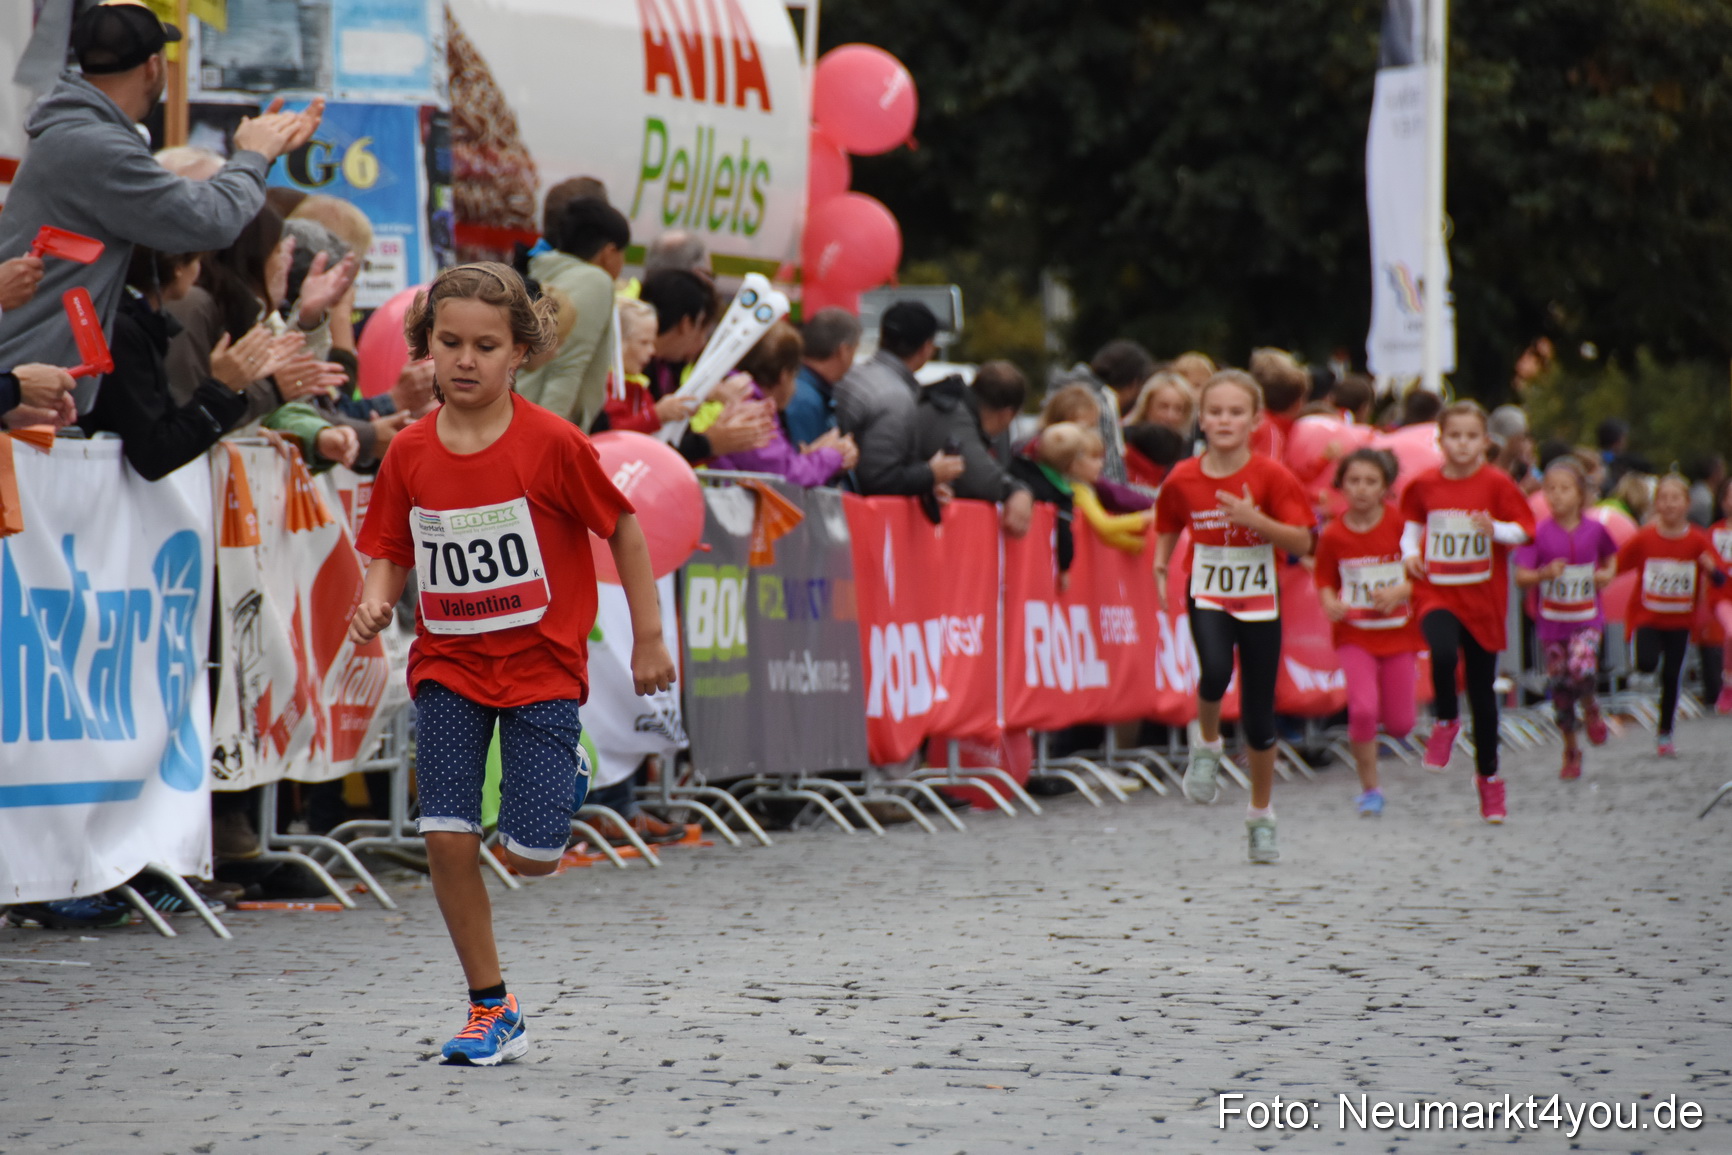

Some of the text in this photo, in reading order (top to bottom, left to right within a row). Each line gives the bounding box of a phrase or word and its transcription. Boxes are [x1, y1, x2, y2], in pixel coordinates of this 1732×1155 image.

[636, 0, 773, 114] AVIA
[630, 115, 771, 238] Pellets
[450, 506, 518, 530] BOCK
[1430, 531, 1487, 558] 7070
[422, 532, 529, 587] 7030
[1201, 564, 1268, 592] 7074
[441, 593, 522, 616] Valentina
